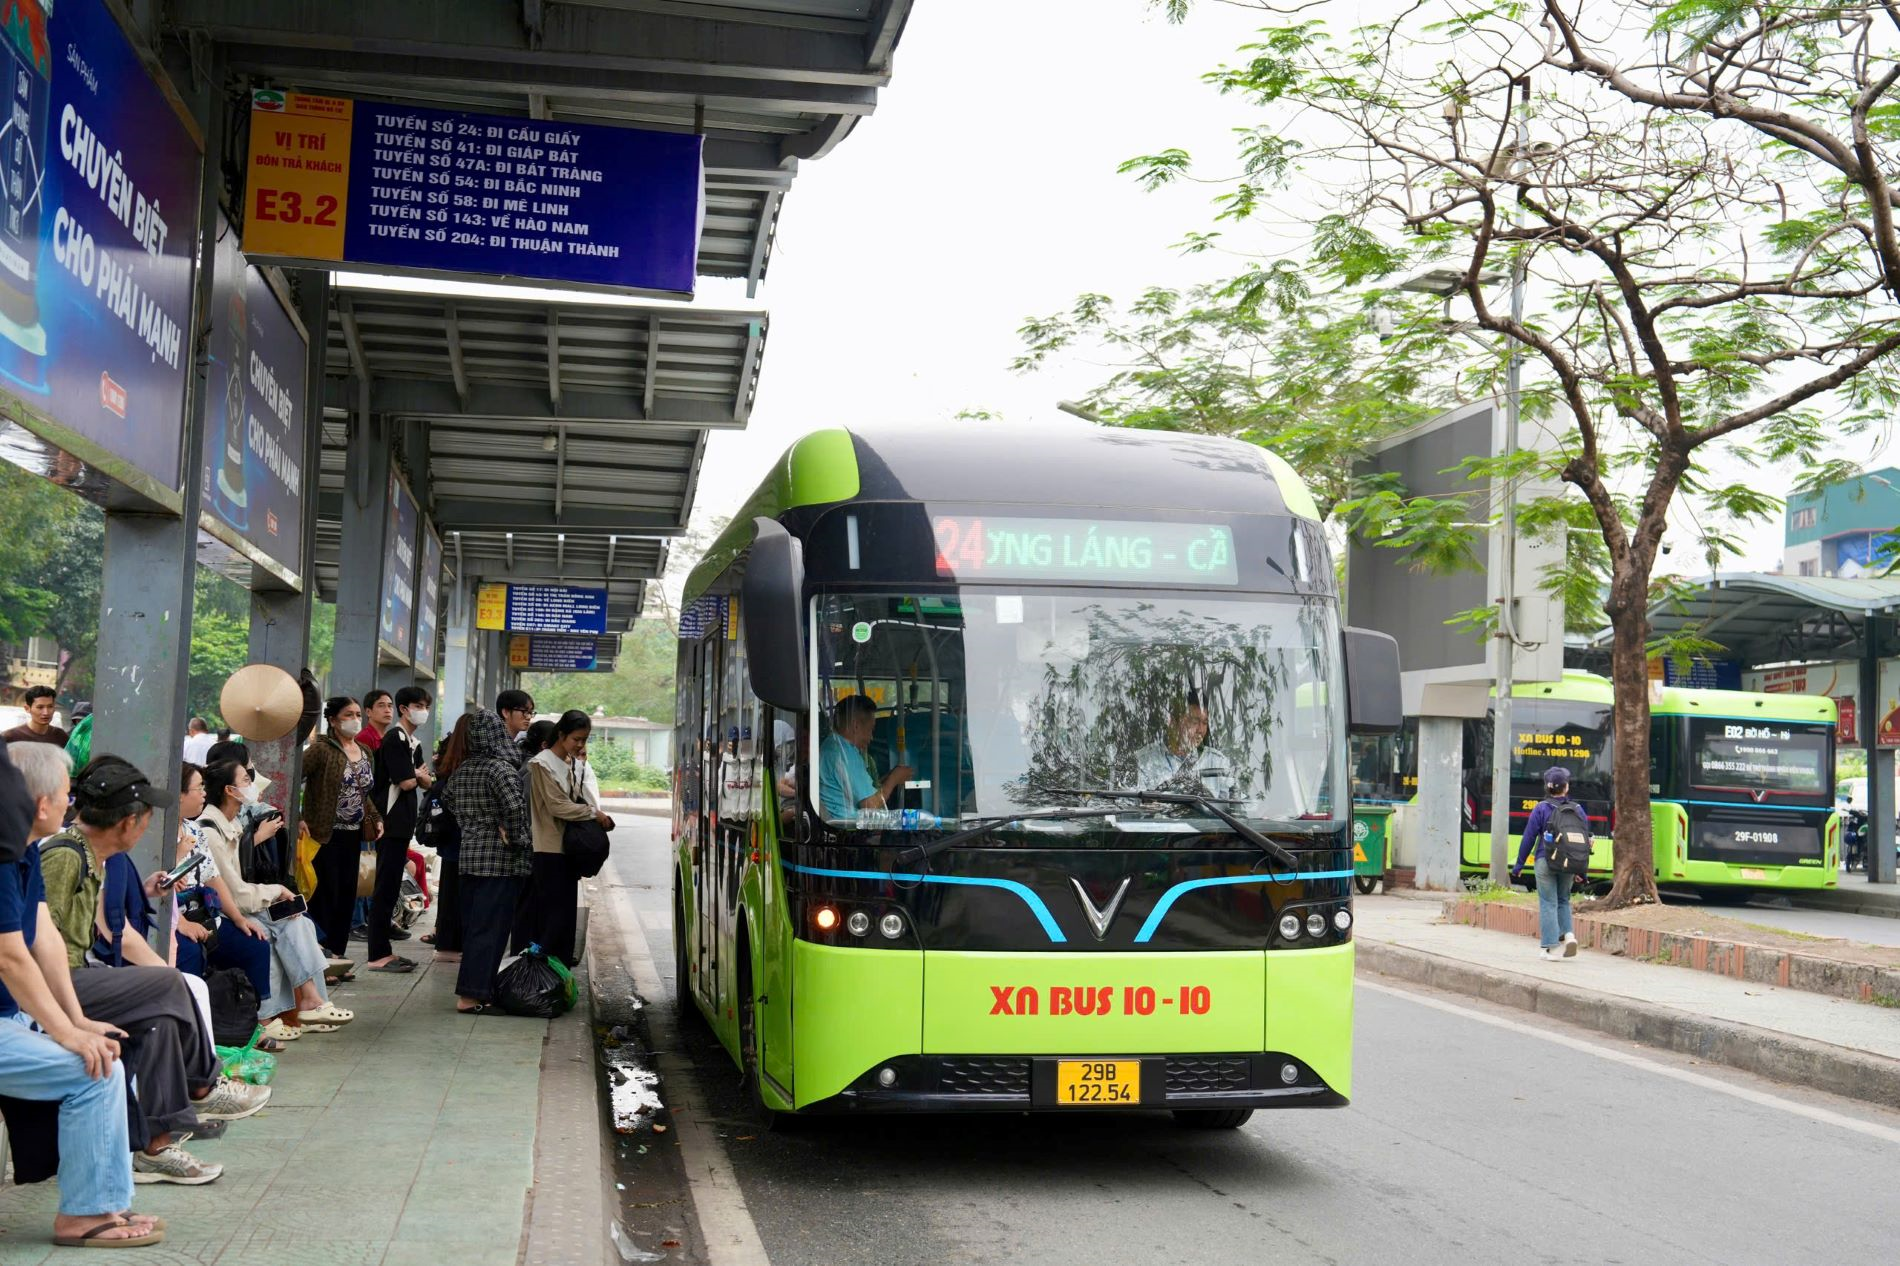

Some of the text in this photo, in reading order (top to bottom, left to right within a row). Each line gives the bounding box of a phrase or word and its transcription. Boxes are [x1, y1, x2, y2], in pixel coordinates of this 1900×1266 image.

[275, 130, 326, 151] VỊ TRÍ
[376, 114, 427, 131] TUYẾN
[432, 118, 454, 133] SỐ
[458, 124, 482, 136] 24:
[487, 126, 503, 139] ĐI
[544, 130, 581, 146] GIẤY
[374, 132, 579, 163] TUYẾN SỐ 41: ĐI GIÁP BÁT
[283, 155, 302, 169] TRẢ
[305, 159, 342, 173] KHÁCH
[373, 149, 603, 182] TUYẾN SỐ 47A: ĐI BÁT TRÀNG
[60, 104, 168, 268] CHUYÊN BIỆT
[372, 167, 581, 198] TUYẾN SỐ 54: ĐI BẮC NINH
[256, 188, 338, 227] E3.2
[371, 186, 422, 202] TUYẾN
[427, 190, 450, 204] SỐ
[453, 194, 477, 207] 58:
[482, 197, 498, 209] ĐI
[532, 202, 569, 216] LINH
[369, 204, 589, 235] TUYẾN SỐ 143: VỀ HÀO NAM
[369, 224, 619, 258] TUYẾN SỐ 204: ĐI THUẬN THÀNH
[53, 206, 95, 287] CHO
[96, 250, 139, 330] PHÁI
[138, 292, 181, 370] MẠNH
[250, 350, 278, 414] CHUYÊN
[278, 388, 293, 435] BIỆT
[248, 414, 263, 459] CHO
[265, 432, 281, 475] PHÁI
[935, 519, 984, 569] 24
[1063, 526, 1152, 569] LÁNG
[1535, 734, 1554, 744] BUS
[1049, 986, 1113, 1016] BUS
[1081, 1063, 1116, 1082] 29B
[1068, 1084, 1131, 1103] 122.54
